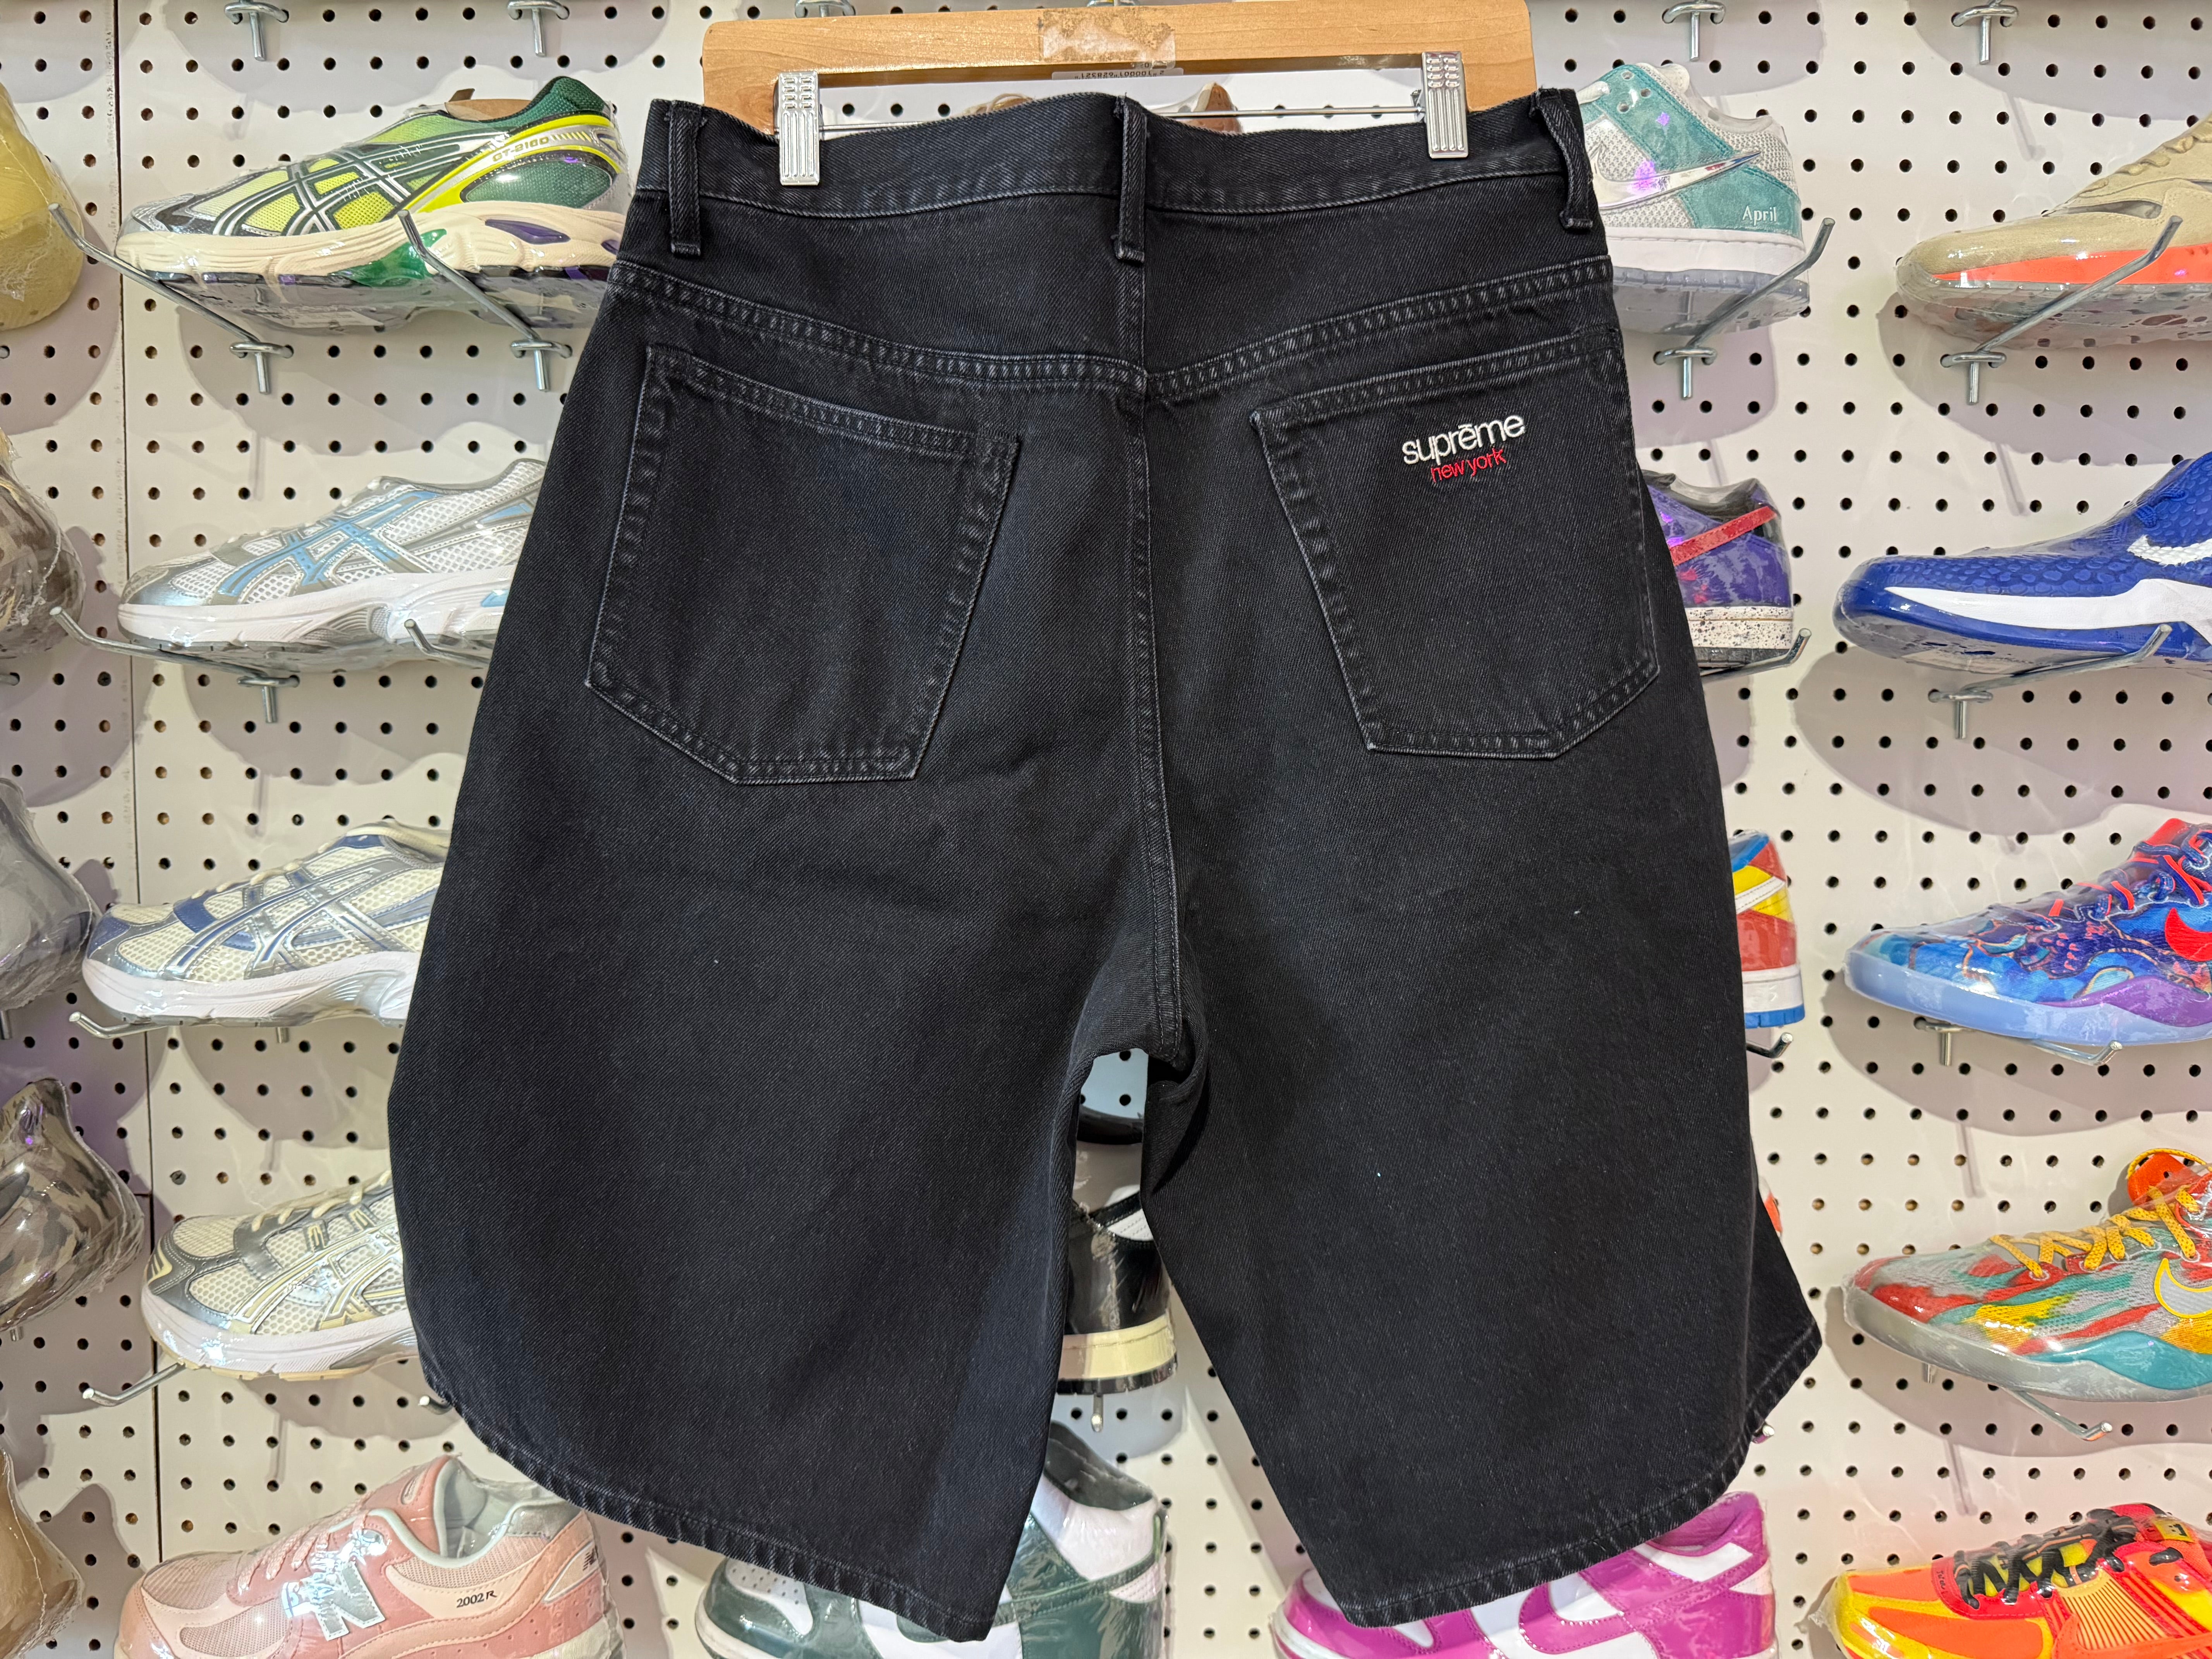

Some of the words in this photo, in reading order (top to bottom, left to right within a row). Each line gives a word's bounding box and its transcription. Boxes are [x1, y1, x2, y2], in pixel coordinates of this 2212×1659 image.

[1742, 205, 1777, 226] April
[1431, 460, 1465, 483] new
[1467, 447, 1506, 477] york
